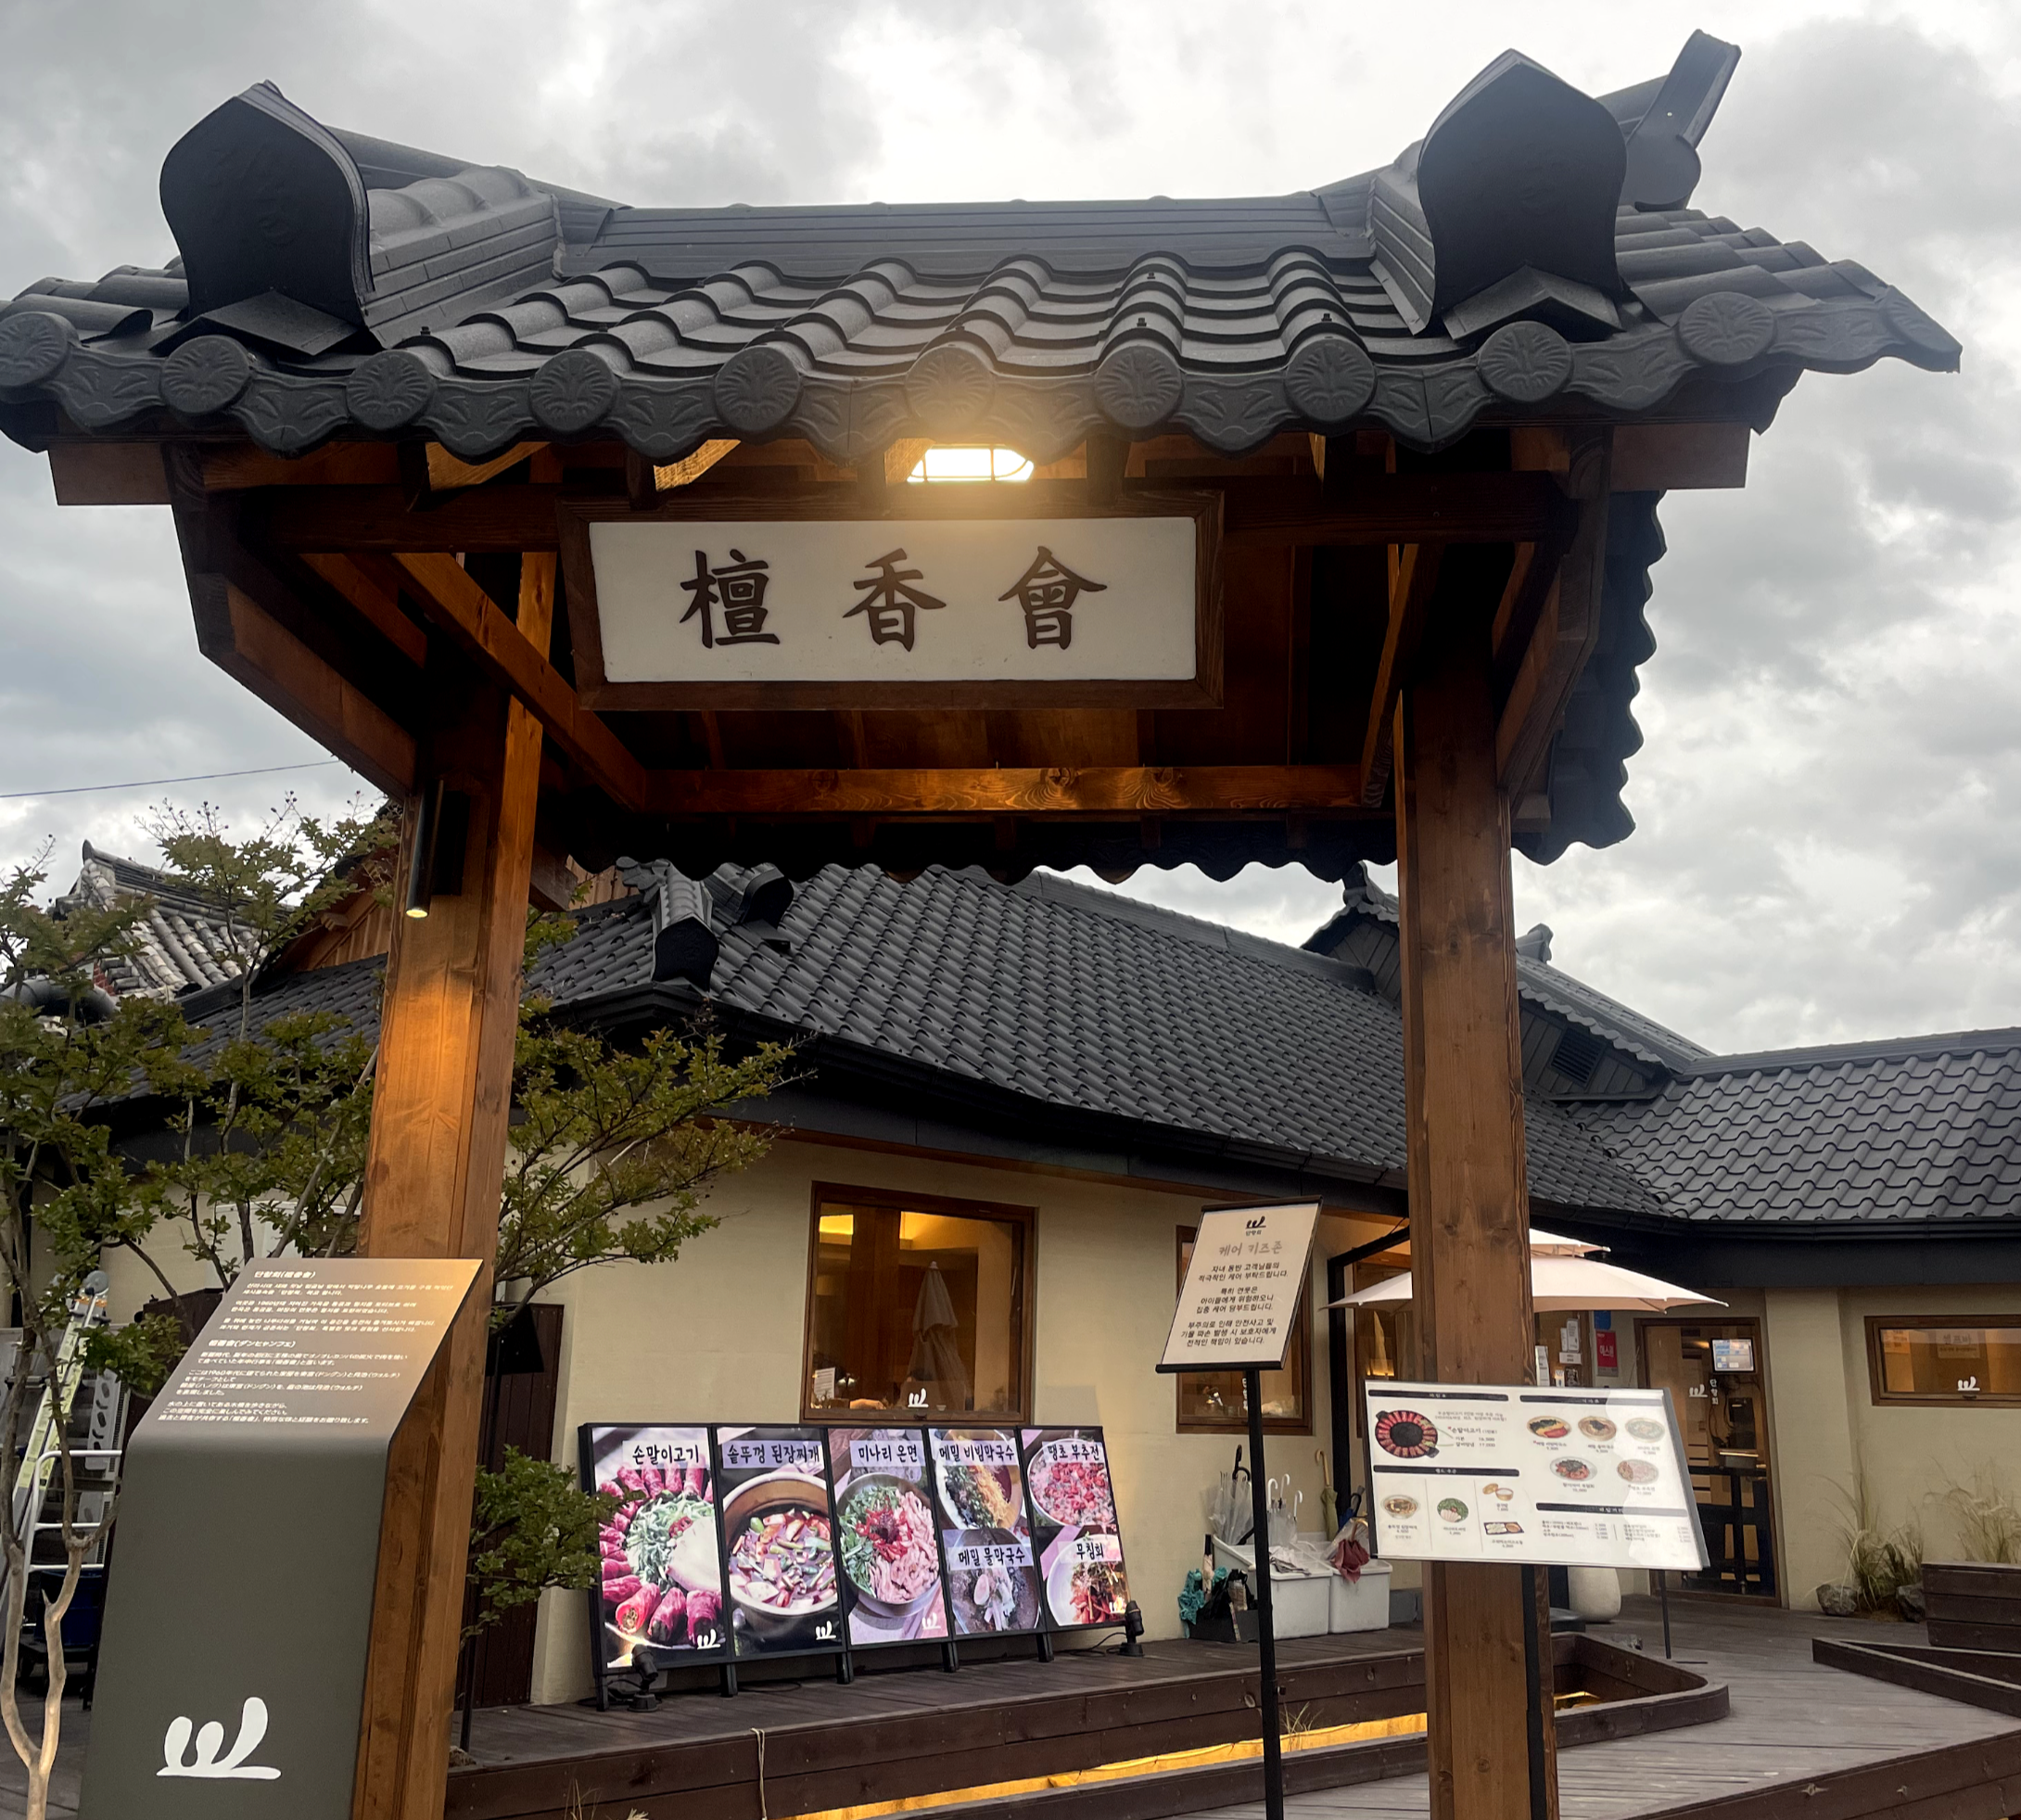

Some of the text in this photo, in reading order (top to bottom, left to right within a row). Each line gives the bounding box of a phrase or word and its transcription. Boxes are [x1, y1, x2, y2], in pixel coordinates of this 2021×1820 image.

[680, 545, 1107, 652] 檀香會
[1219, 1241, 1283, 1256] 케어 키즈존
[632, 1444, 700, 1466] 손말이고기
[727, 1444, 820, 1465] 솥뚜껑 된장찌개
[858, 1444, 918, 1463] 미나리 온면
[939, 1444, 1015, 1464] 메밀 비빔막국수
[1047, 1443, 1100, 1462] 땡초 부추전
[959, 1546, 1025, 1567] 메밀 물막국수
[1076, 1542, 1104, 1560] 무침회
